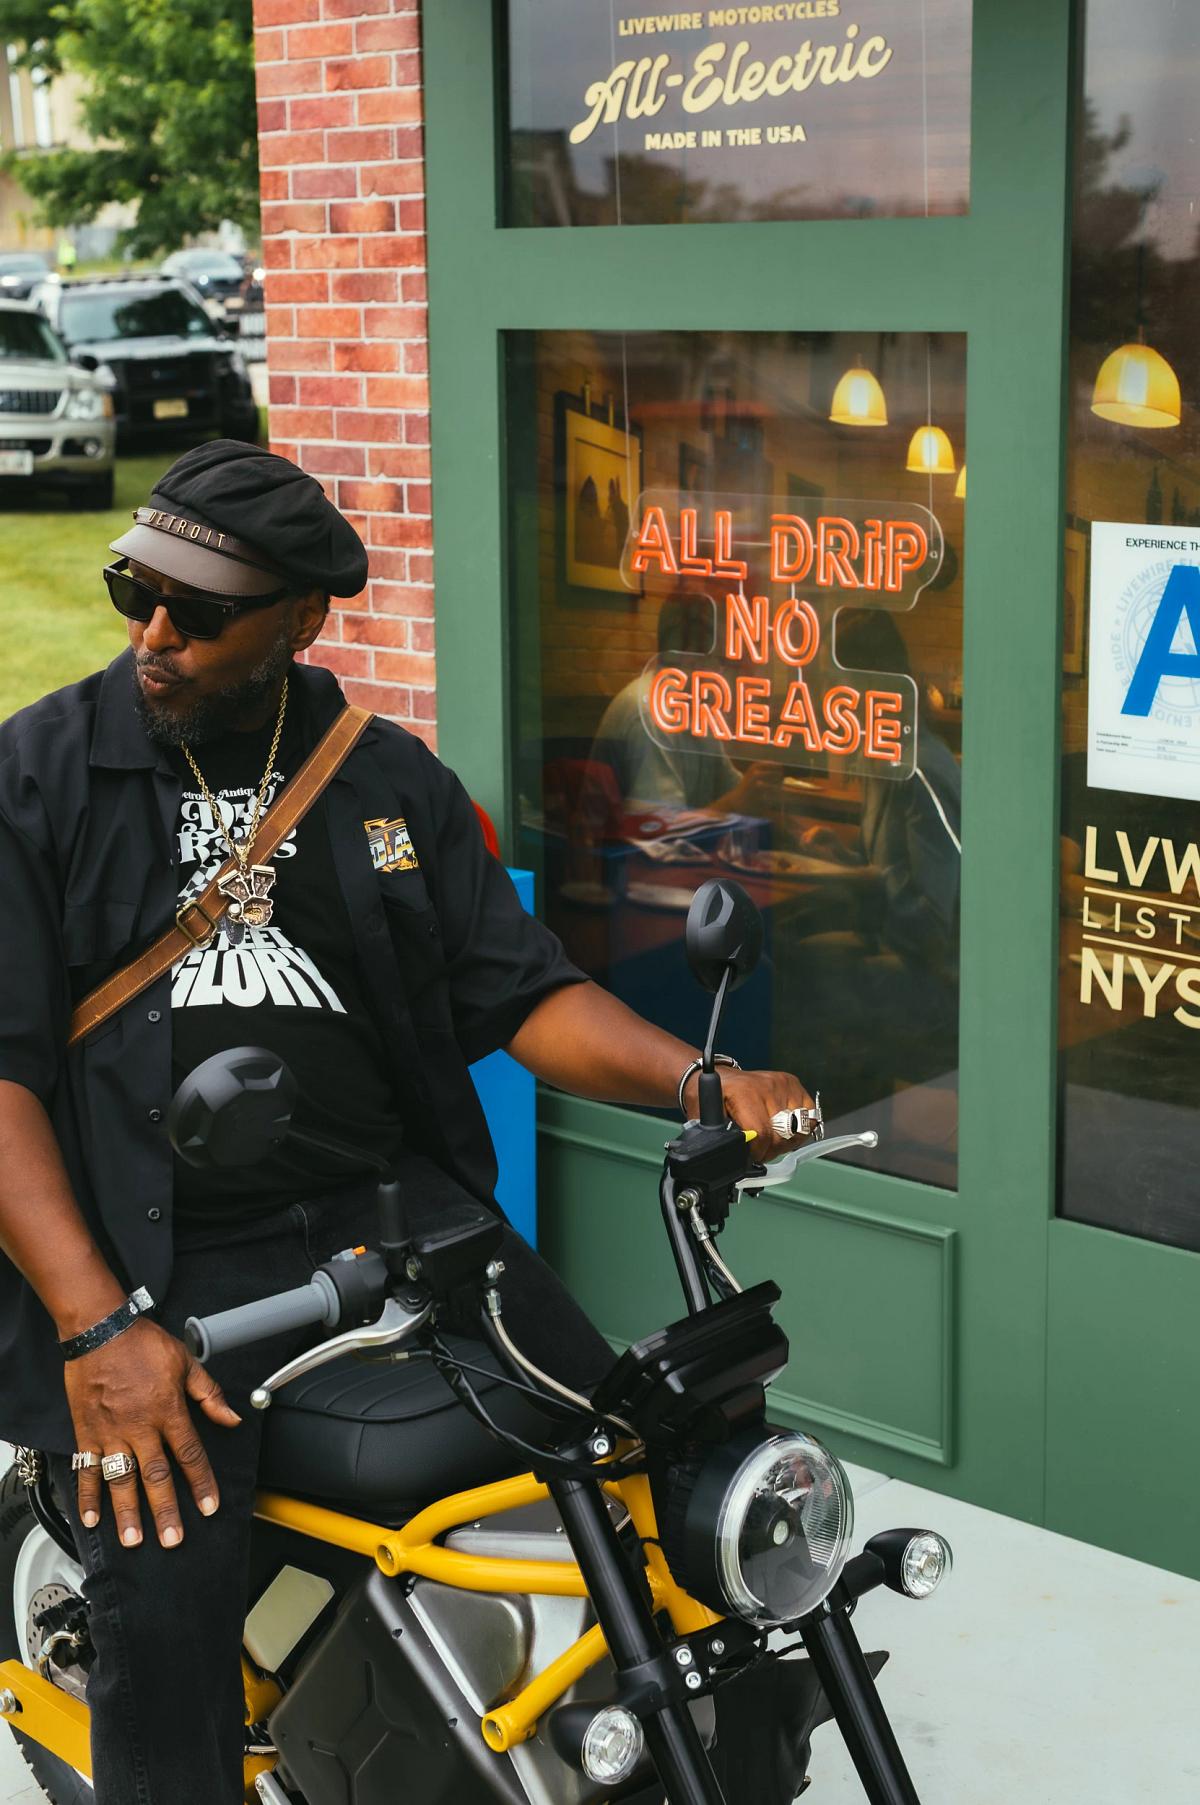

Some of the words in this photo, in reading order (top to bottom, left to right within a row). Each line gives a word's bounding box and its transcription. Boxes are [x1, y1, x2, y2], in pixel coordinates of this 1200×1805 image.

[618, 12, 703, 36] LIVEWIRE
[708, 0, 840, 27] MOTORCYCLES
[569, 23, 893, 145] All-Electric
[644, 130, 697, 150] MADE
[702, 130, 722, 148] IN
[726, 127, 762, 147] THE
[766, 125, 806, 144] USA
[148, 510, 226, 548] DETROIT
[630, 506, 748, 580] ALL
[770, 513, 928, 592] DRIP
[1125, 537, 1187, 551] EXPERIENCE
[725, 592, 820, 667] NO
[649, 667, 903, 762] GREASE
[1082, 896, 1191, 945] LIST
[171, 947, 348, 1014] GLORY
[1080, 946, 1200, 1030] NYS
